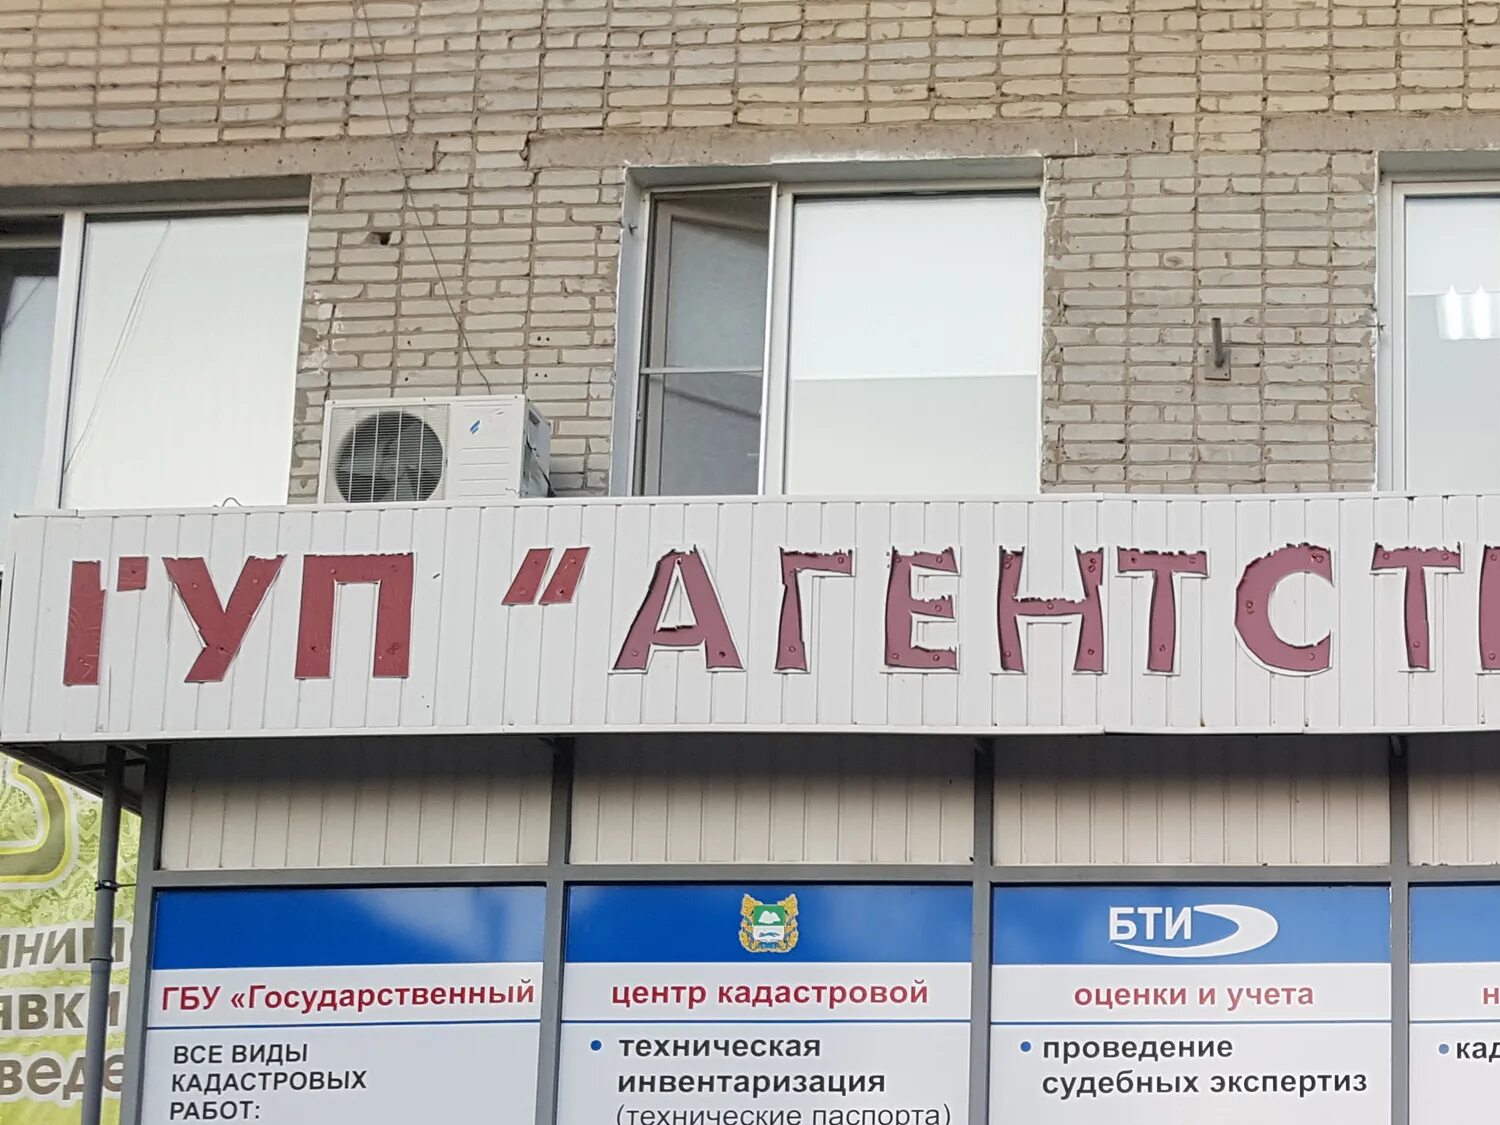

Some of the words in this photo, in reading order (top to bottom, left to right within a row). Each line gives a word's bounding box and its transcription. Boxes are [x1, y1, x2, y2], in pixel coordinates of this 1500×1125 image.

[1109, 906, 1193, 942] БТИ
[162, 986, 220, 1010] ГБУ
[231, 978, 534, 1014] «Государственный
[611, 983, 707, 1009] центр
[718, 979, 929, 1008] кадастровой
[1075, 986, 1187, 1009] оценки
[1198, 986, 1217, 1005] и
[1227, 985, 1315, 1011] учета
[173, 1045, 222, 1065] ВСЕ
[232, 1044, 308, 1065] ВИДЫ
[618, 1037, 821, 1057] техническая
[1043, 1038, 1234, 1063] проведение
[172, 1071, 367, 1093] КАДАСТРОВЫХ
[617, 1073, 886, 1097] инвентаризация
[1042, 1070, 1198, 1099] судебных
[1210, 1073, 1368, 1098] экспертиз
[170, 1101, 260, 1120] РАБОТ:
